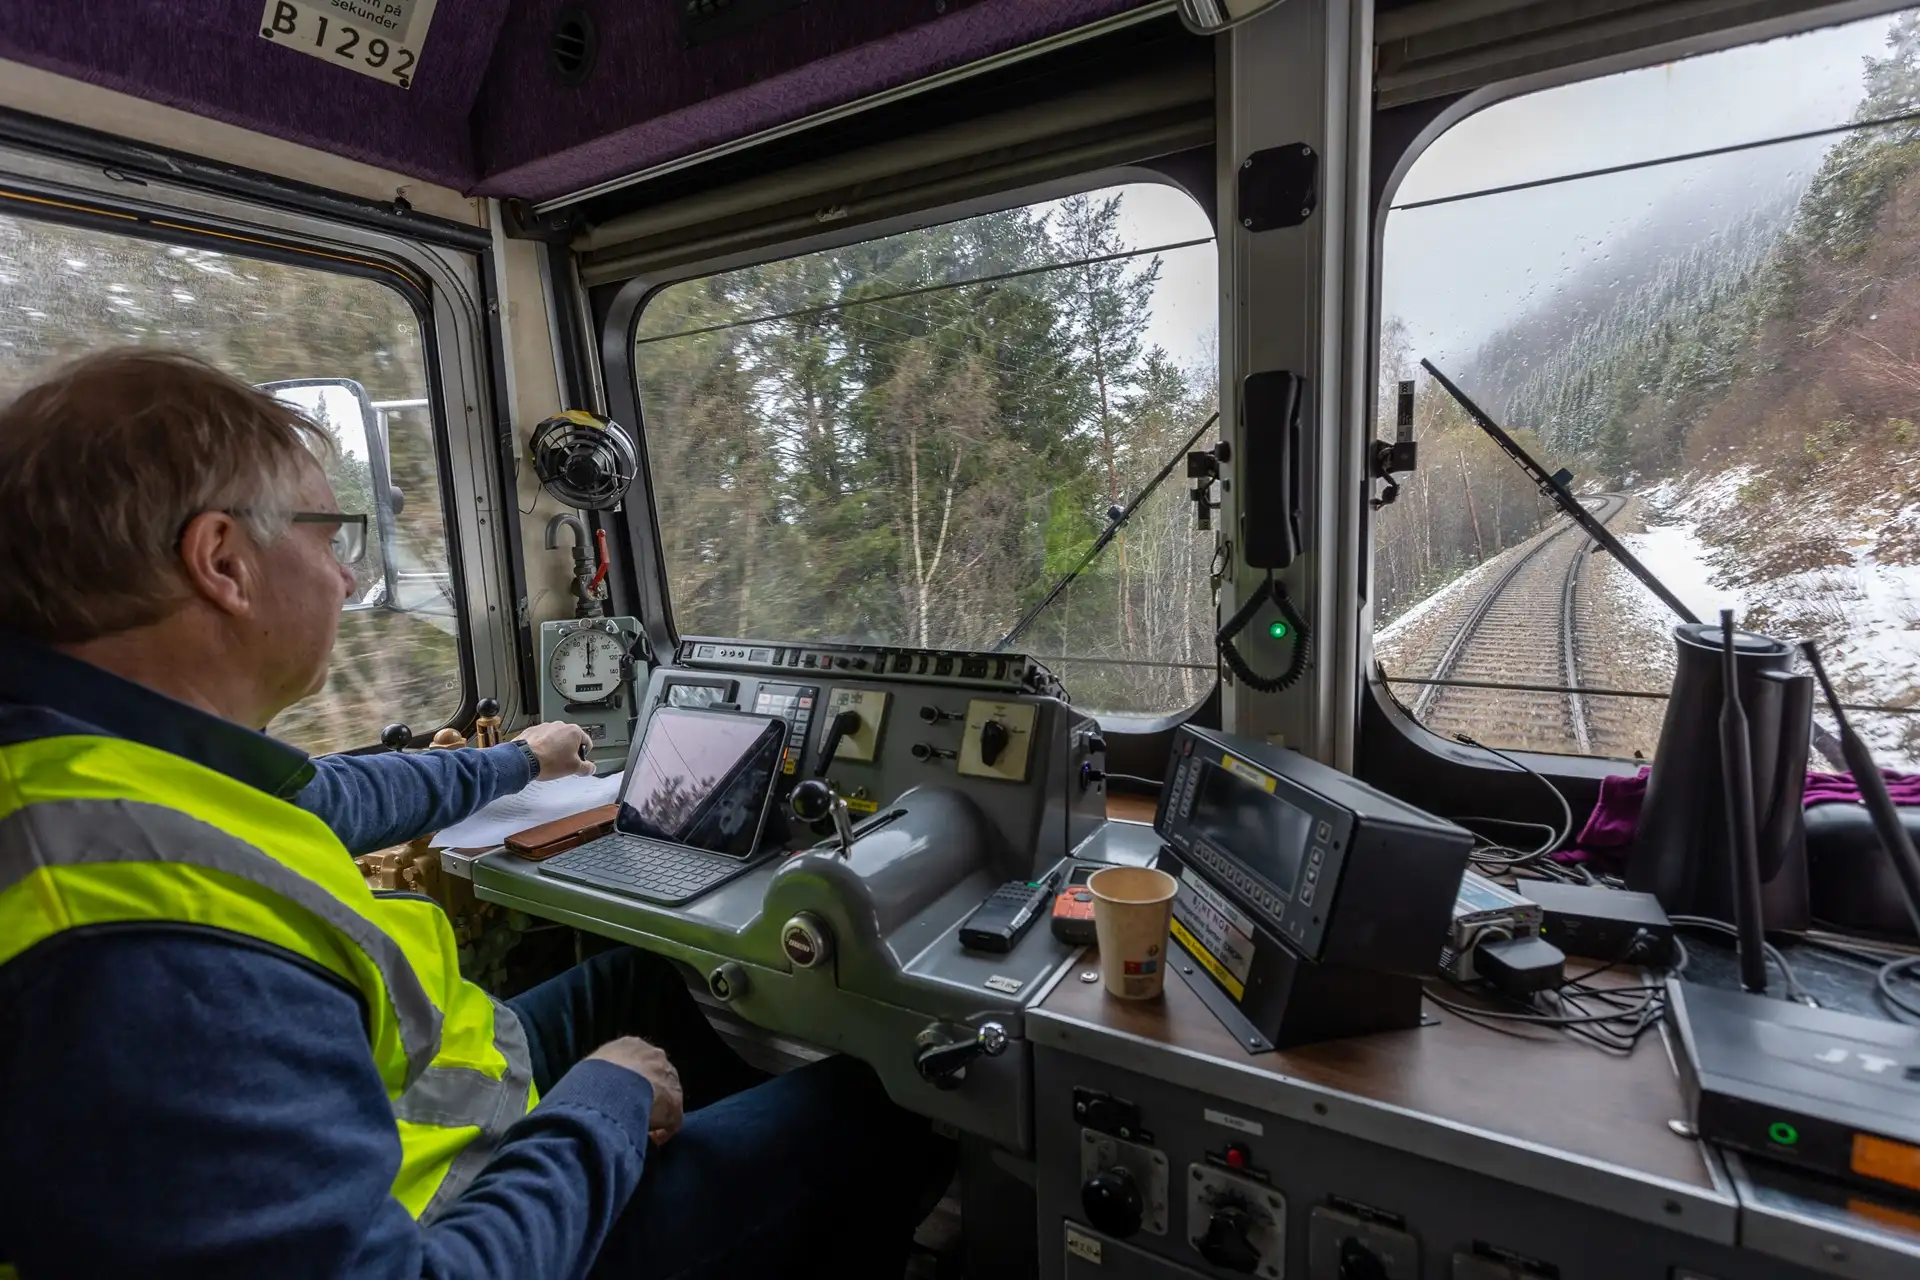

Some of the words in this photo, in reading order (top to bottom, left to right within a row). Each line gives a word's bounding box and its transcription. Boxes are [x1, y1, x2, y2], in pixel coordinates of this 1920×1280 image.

[331, 0, 399, 30] sekunder
[384, 4, 402, 18] på
[271, 0, 298, 35] B
[315, 16, 415, 80] 1292
